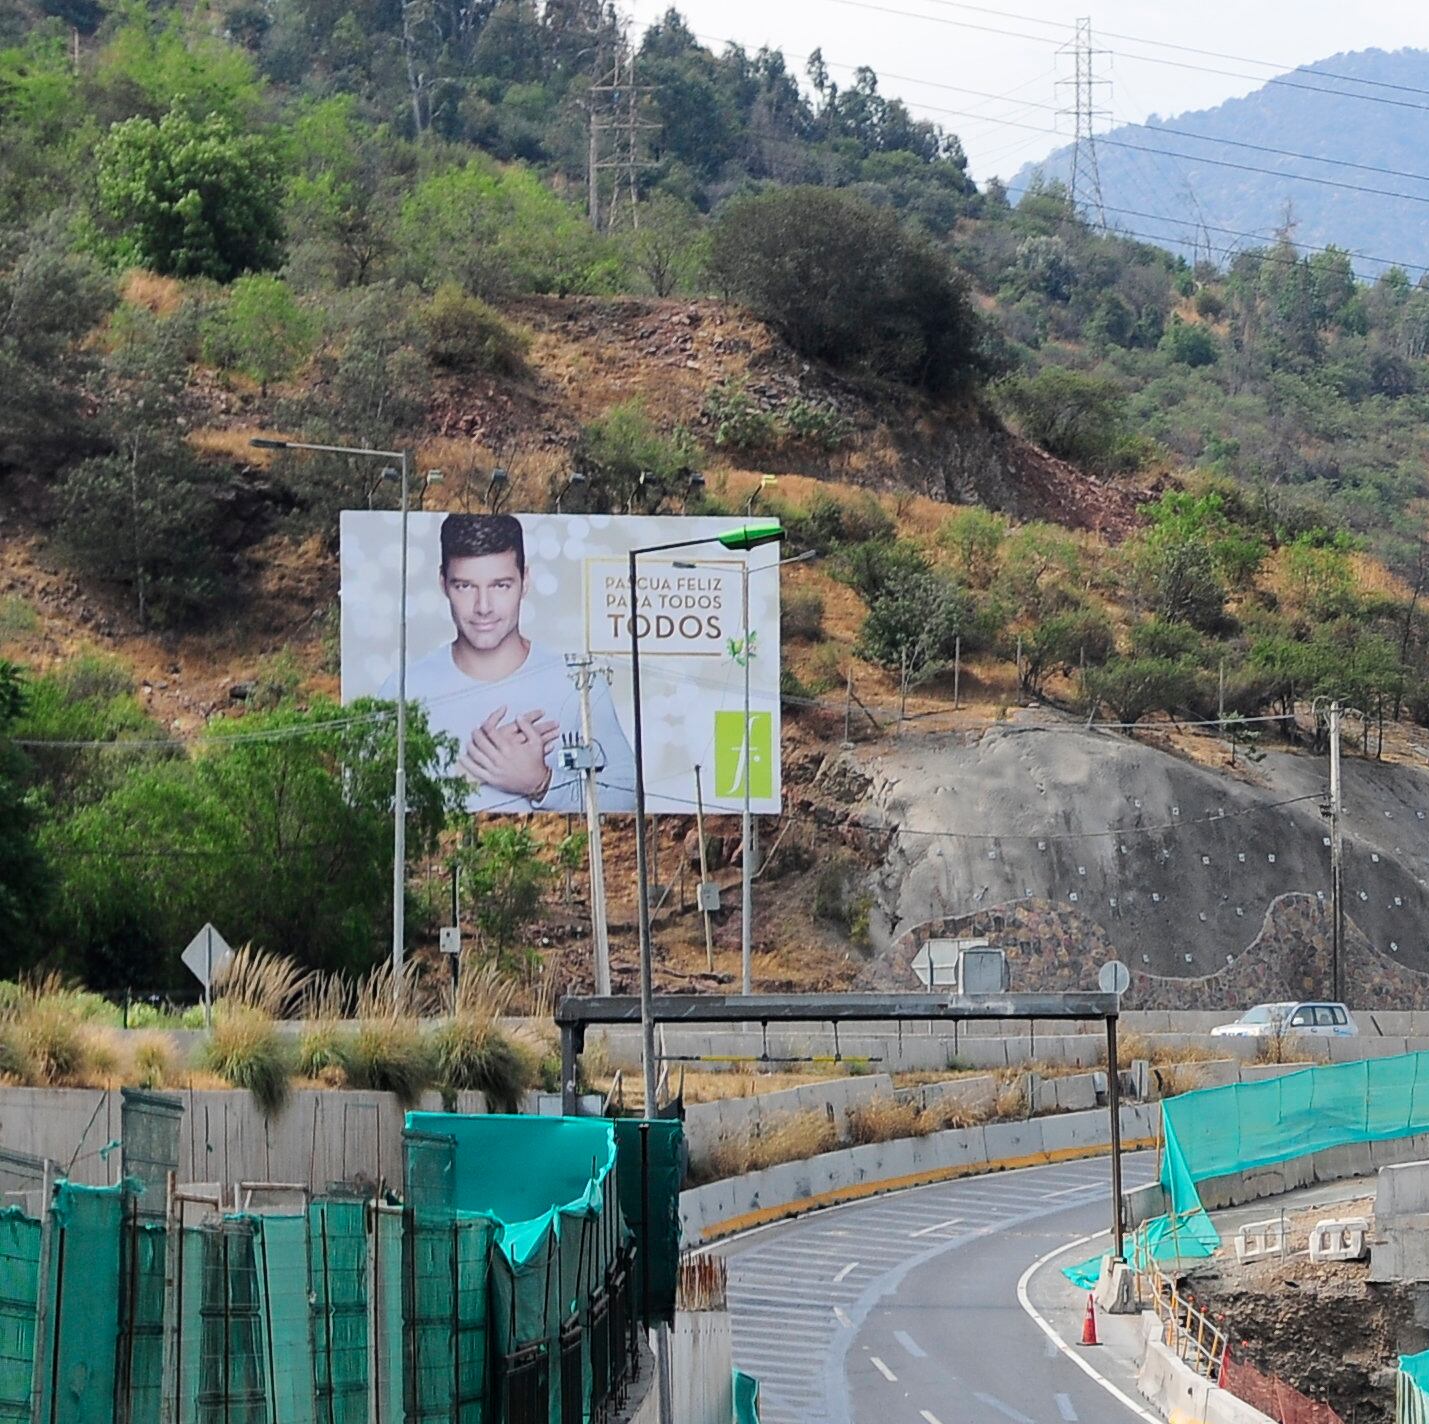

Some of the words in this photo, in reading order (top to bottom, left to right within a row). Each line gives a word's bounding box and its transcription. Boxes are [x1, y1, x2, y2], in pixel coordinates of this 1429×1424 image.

[677, 578, 722, 591] FELIZ
[660, 595, 722, 609] TODOS
[607, 614, 721, 639] TODOS
